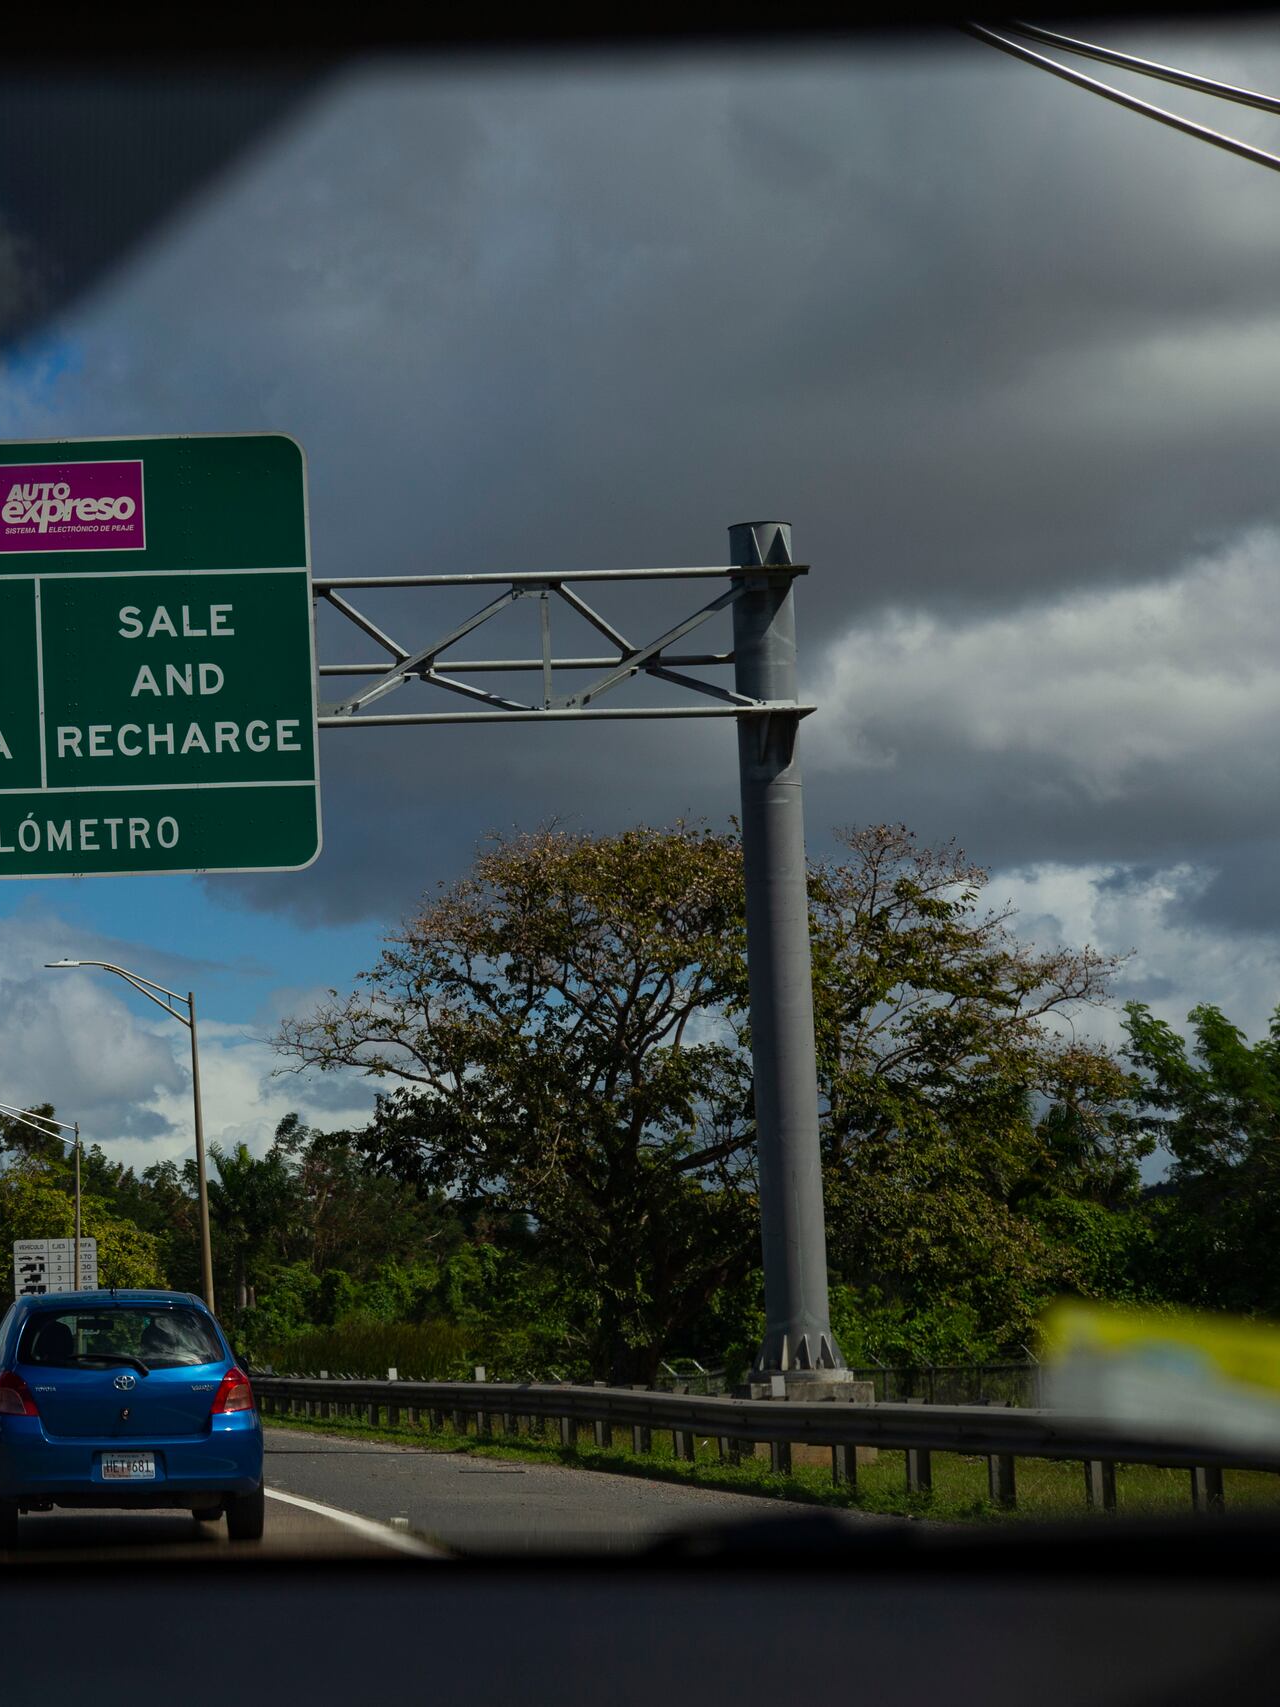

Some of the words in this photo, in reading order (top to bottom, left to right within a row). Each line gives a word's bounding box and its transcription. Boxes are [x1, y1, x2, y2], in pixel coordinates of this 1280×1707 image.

[6, 482, 70, 502] AUTO
[1, 496, 136, 533] expreso
[5, 527, 36, 535] SISTEMA
[111, 524, 135, 532] PEAJE
[118, 604, 235, 638] SALE
[131, 663, 224, 697] AND
[57, 719, 302, 758] RECHARGE
[106, 1459, 126, 1473] HET
[132, 1459, 151, 1473] 681
